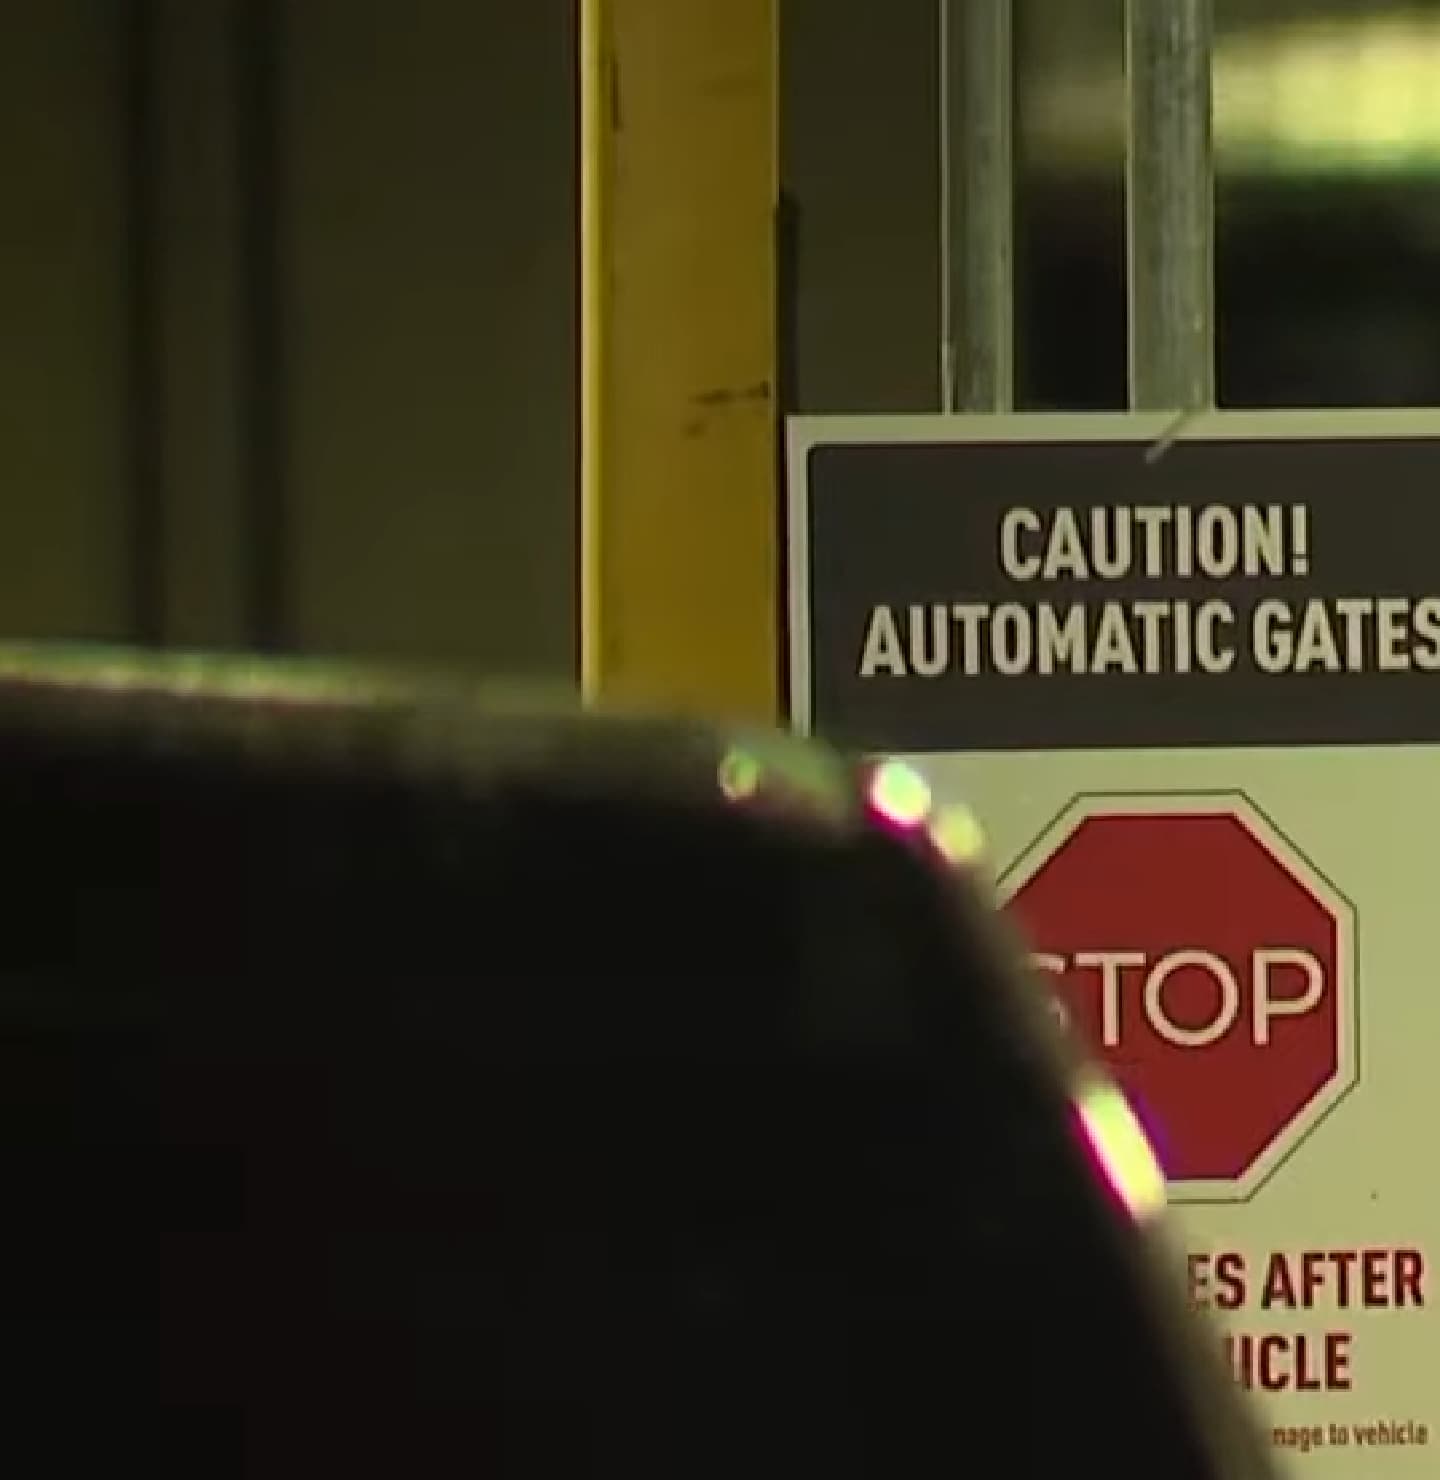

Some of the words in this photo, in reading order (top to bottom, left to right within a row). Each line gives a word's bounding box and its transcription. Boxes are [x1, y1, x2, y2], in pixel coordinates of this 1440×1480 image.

[1002, 504, 1309, 580] CAUTION!
[861, 599, 1236, 677] AUTOMATIC
[1187, 1253, 1248, 1309] ES
[1261, 1251, 1426, 1309] AFTER
[1225, 1333, 1353, 1392] ICLE
[1329, 1423, 1349, 1446] to
[1353, 1420, 1428, 1446] vehicle
